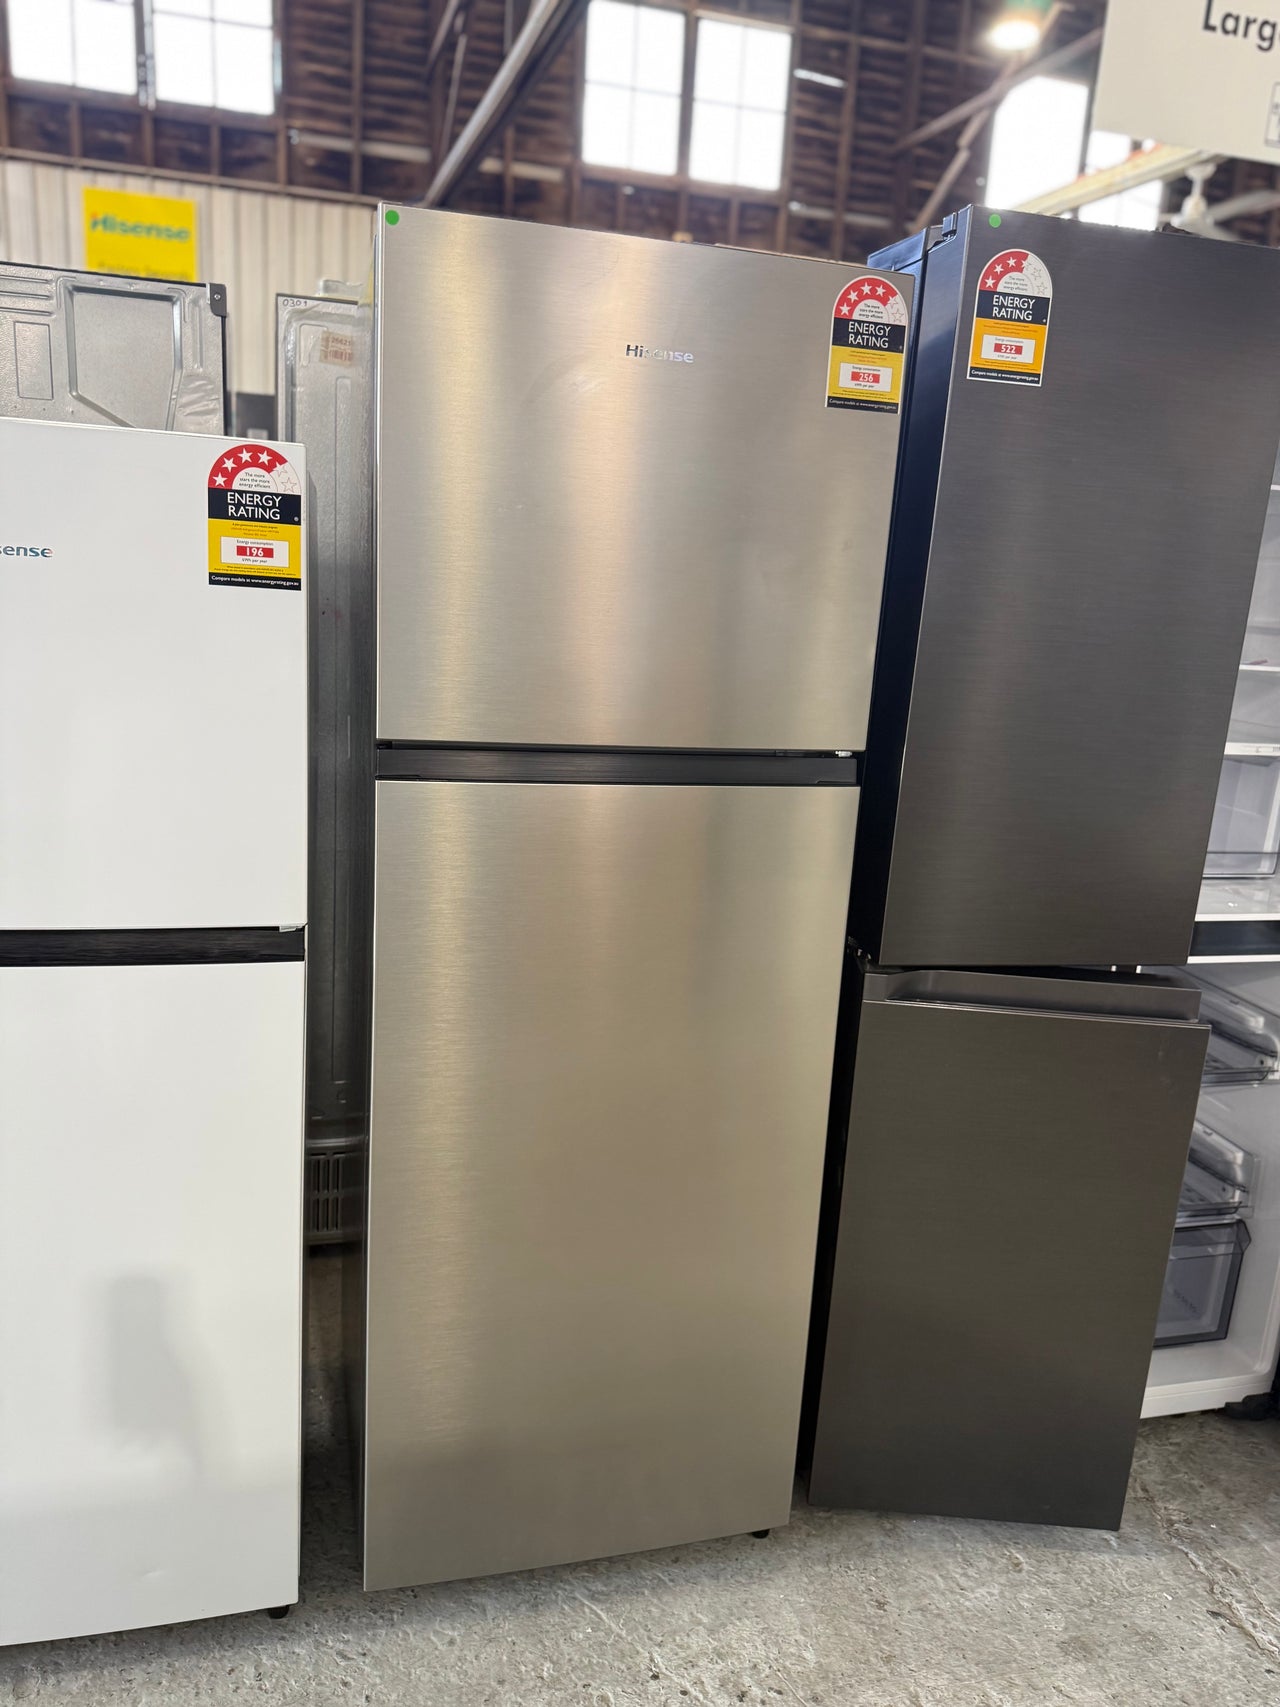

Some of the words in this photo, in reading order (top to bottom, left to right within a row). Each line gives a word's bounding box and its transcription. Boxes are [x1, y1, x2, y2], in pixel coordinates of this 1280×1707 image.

[1203, 0, 1280, 52] Larg
[90, 212, 191, 243] Hisense
[993, 295, 1035, 309] ENERGY
[992, 307, 1032, 321] RATING
[848, 321, 891, 336] ENERGY
[849, 334, 889, 348] RATING
[626, 344, 694, 363] Hisense
[1000, 345, 1016, 354] 522
[859, 373, 873, 382] 256
[227, 492, 282, 507] ENERGY
[228, 505, 280, 520] RATING
[0, 545, 53, 558] ense
[246, 547, 264, 557] 196
